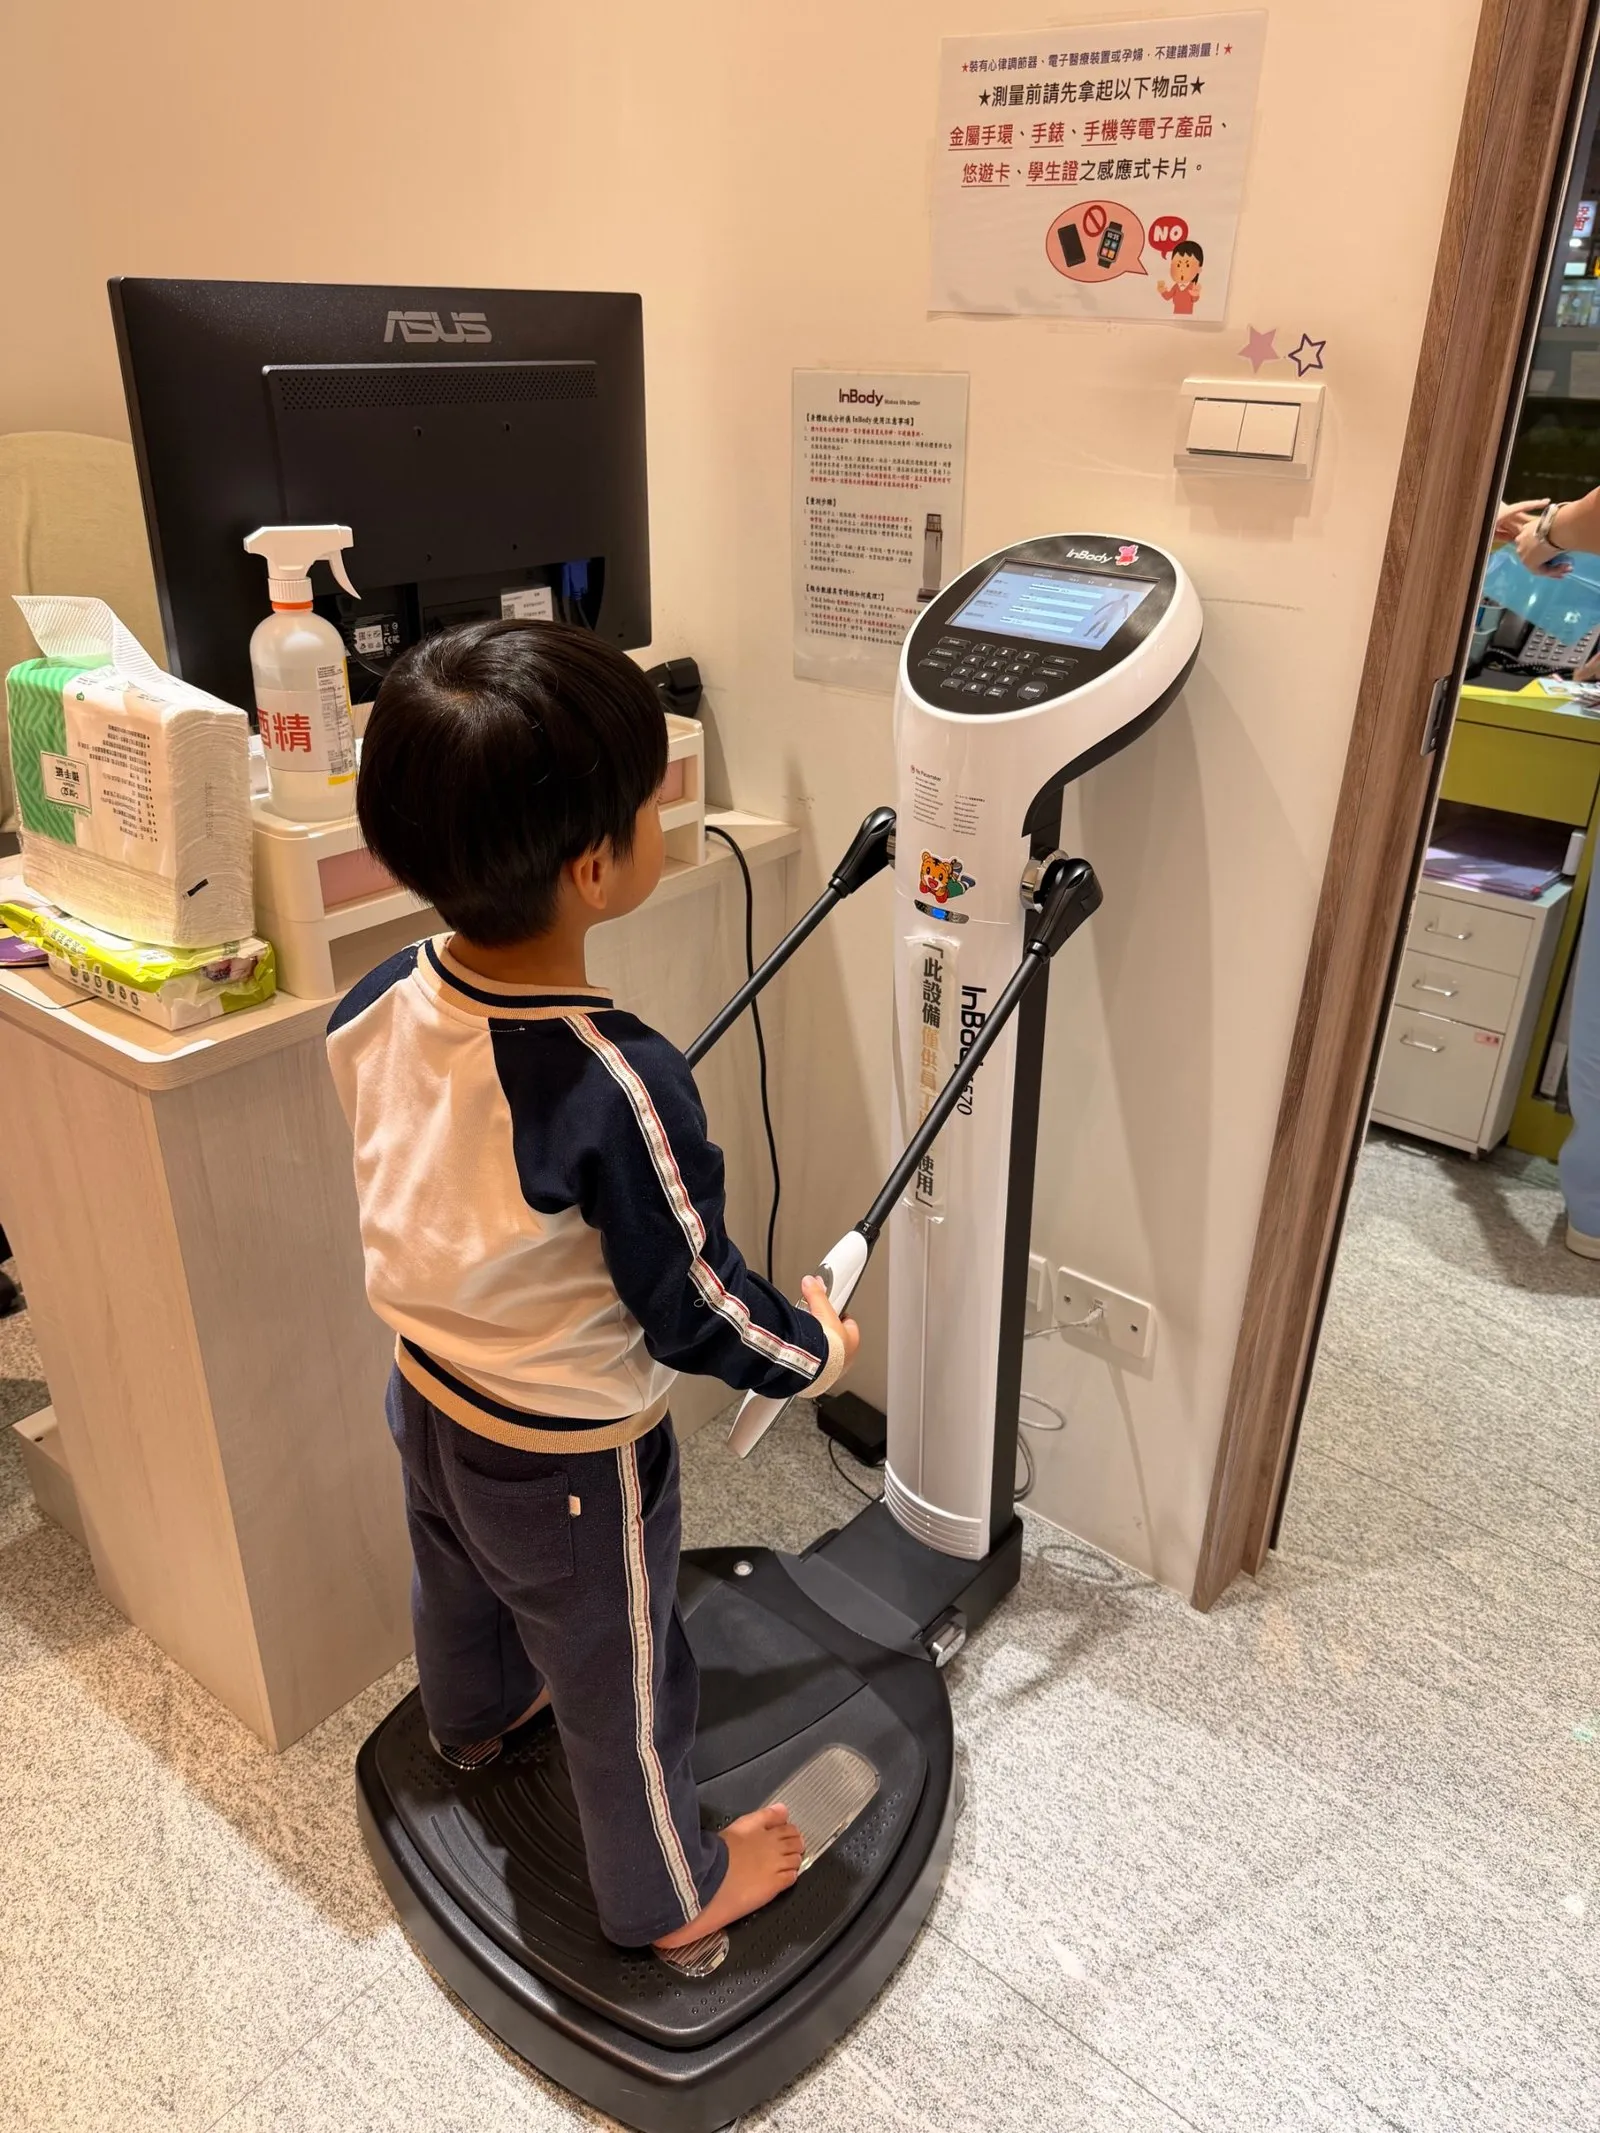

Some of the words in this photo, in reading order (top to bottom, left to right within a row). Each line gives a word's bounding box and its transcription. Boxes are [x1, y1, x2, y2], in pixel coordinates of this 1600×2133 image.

[991, 74, 1188, 107] 測量前請先拿起以下物品
[1153, 225, 1183, 242] NO
[383, 310, 493, 343] ASUS
[838, 388, 884, 407] InBody
[1066, 549, 1113, 564] InBody
[953, 985, 987, 1082] InBo
[915, 942, 944, 1208] 「此設備僅供員工使用」
